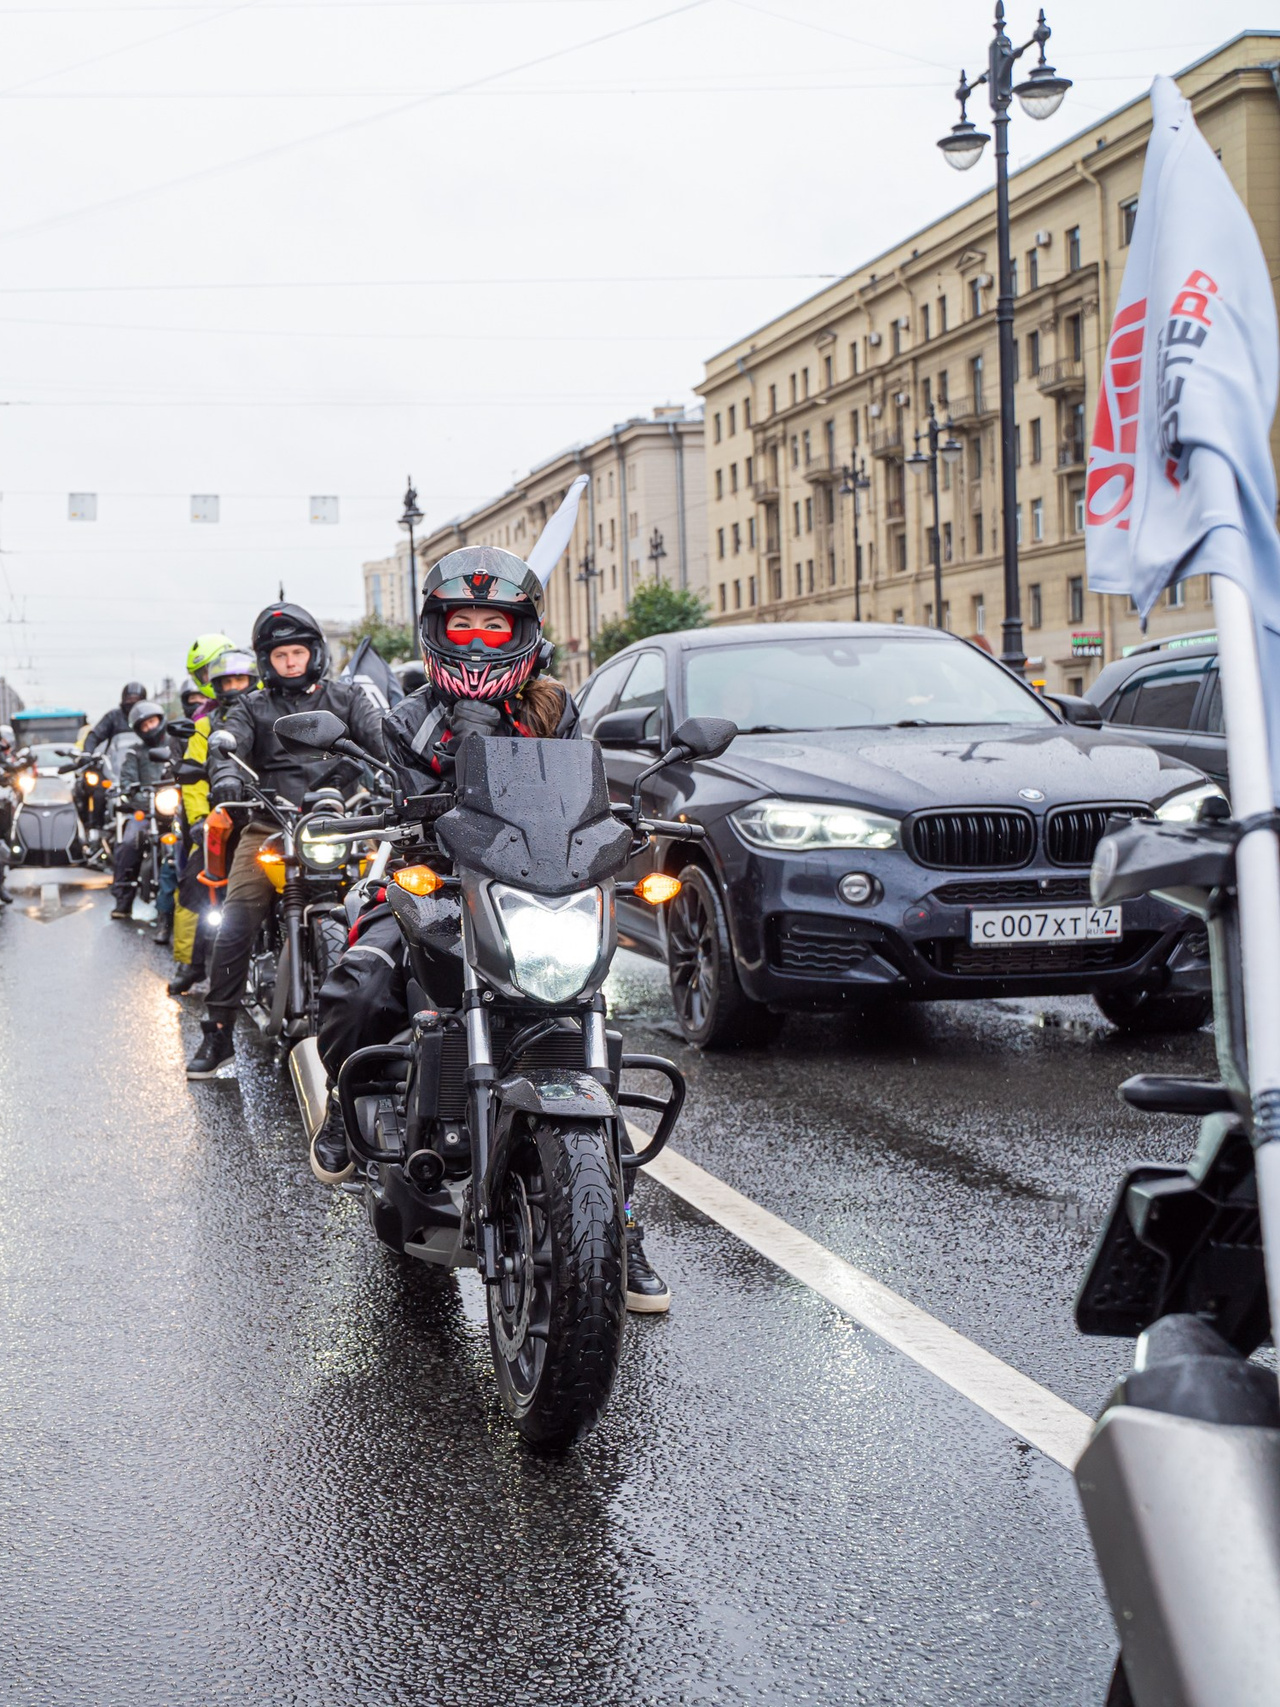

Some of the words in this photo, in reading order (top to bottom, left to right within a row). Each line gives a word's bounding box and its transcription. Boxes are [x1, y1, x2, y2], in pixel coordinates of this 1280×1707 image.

[982, 913, 1082, 939] С007ХТ
[1090, 909, 1113, 928] 47
[1086, 927, 1105, 935] RUS
